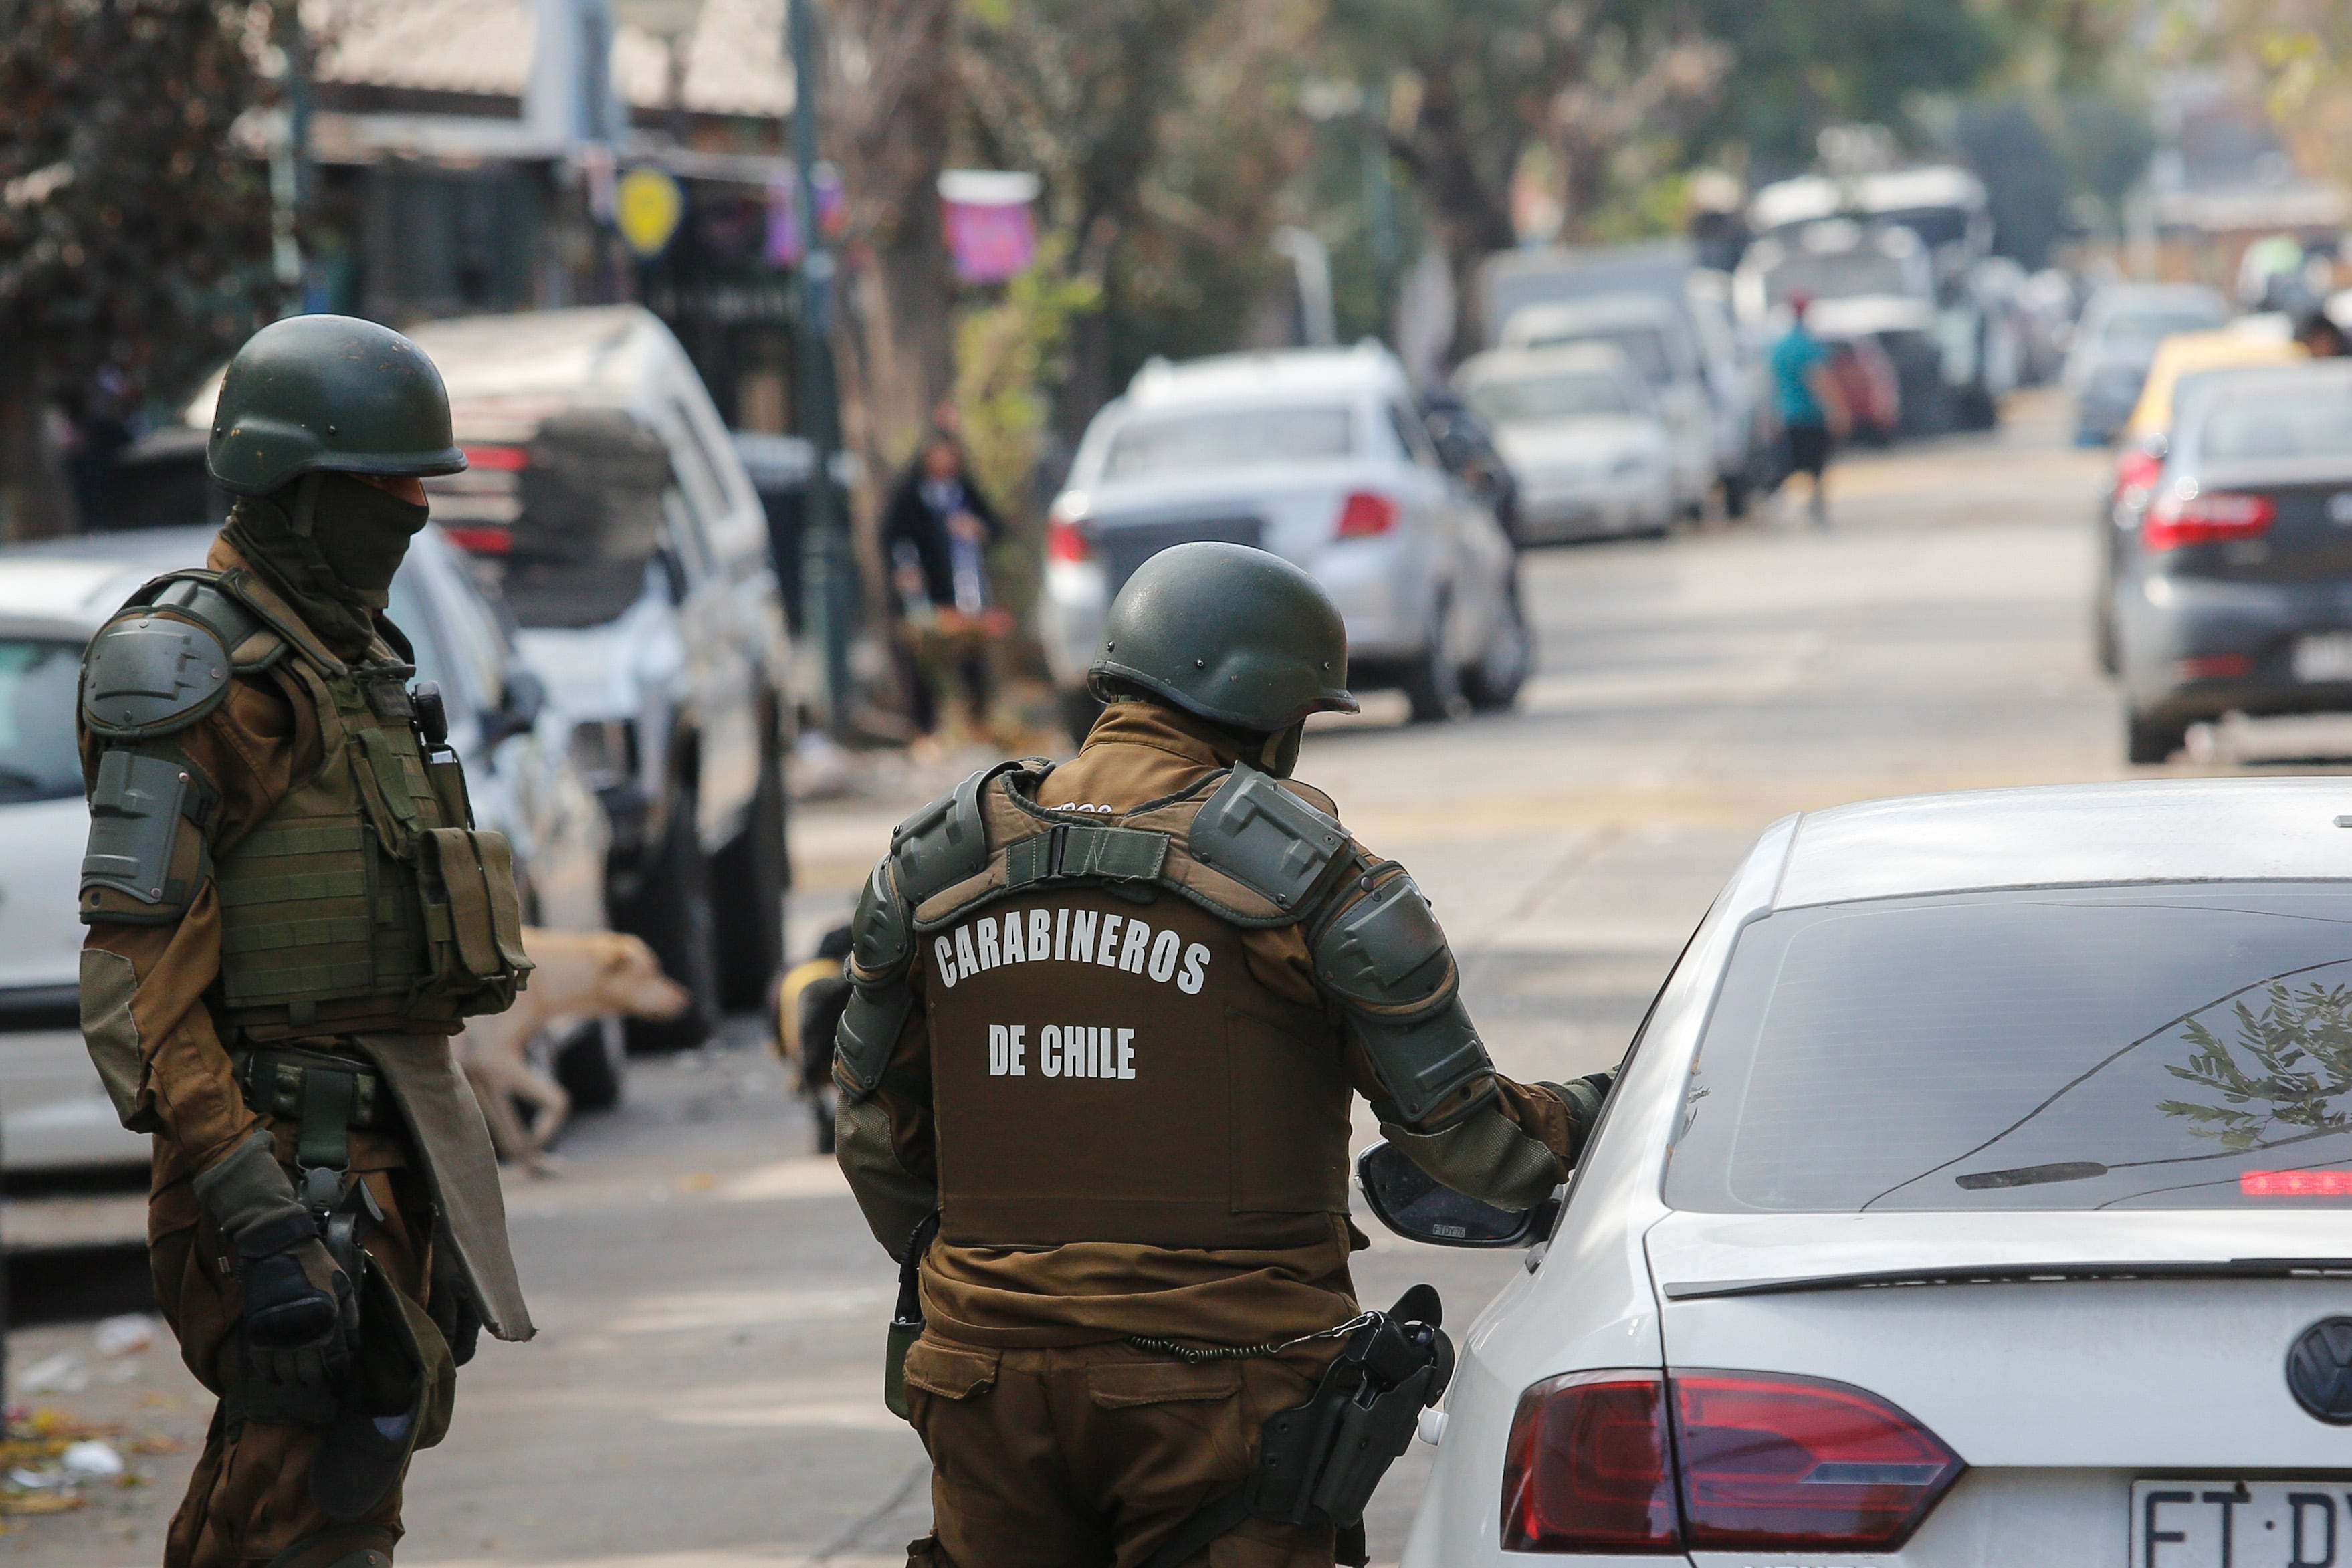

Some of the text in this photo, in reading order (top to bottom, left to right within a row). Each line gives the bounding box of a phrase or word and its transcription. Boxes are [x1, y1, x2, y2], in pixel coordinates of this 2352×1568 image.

[934, 908, 1211, 994] CARABINEROS
[990, 1024, 1136, 1079] DE CHILE
